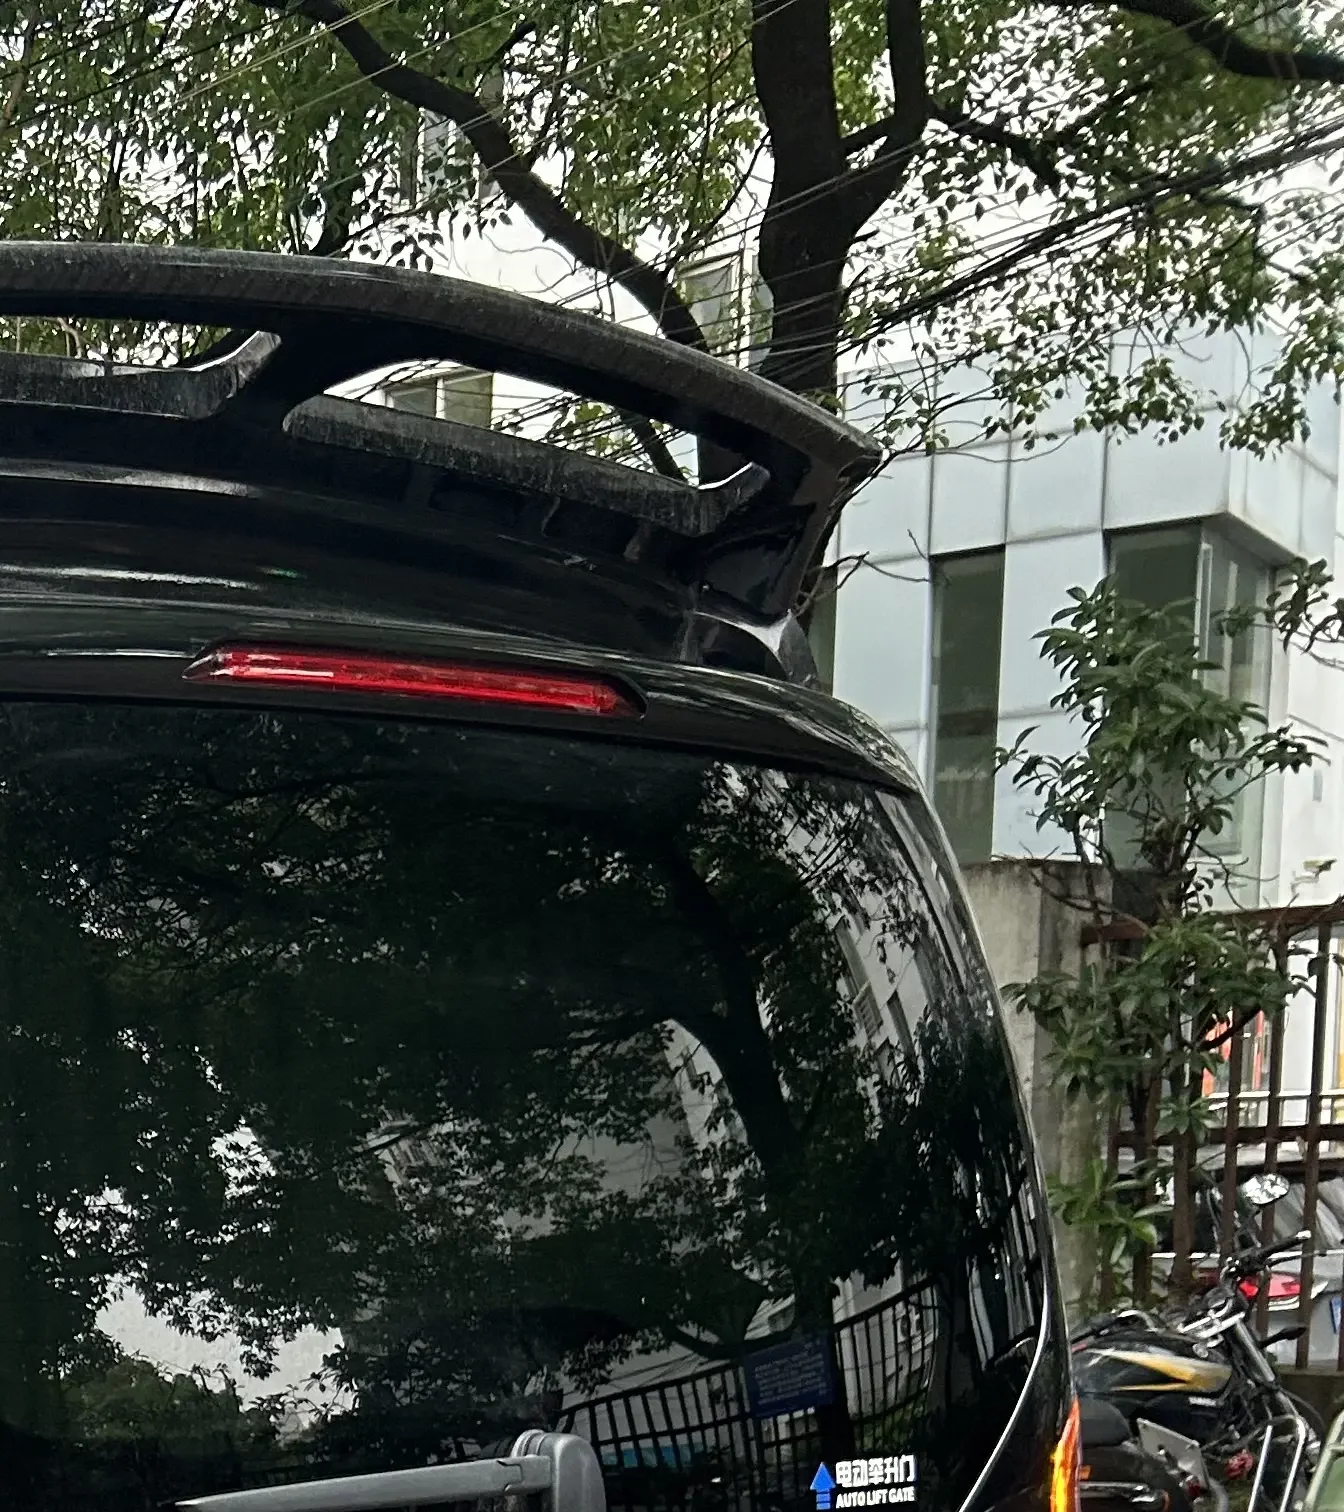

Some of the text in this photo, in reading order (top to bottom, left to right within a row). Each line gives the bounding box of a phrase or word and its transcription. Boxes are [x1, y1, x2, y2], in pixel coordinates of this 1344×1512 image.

[835, 1454, 915, 1488] 电动举升门
[835, 1486, 916, 1509] AUTO LIFT GATE
